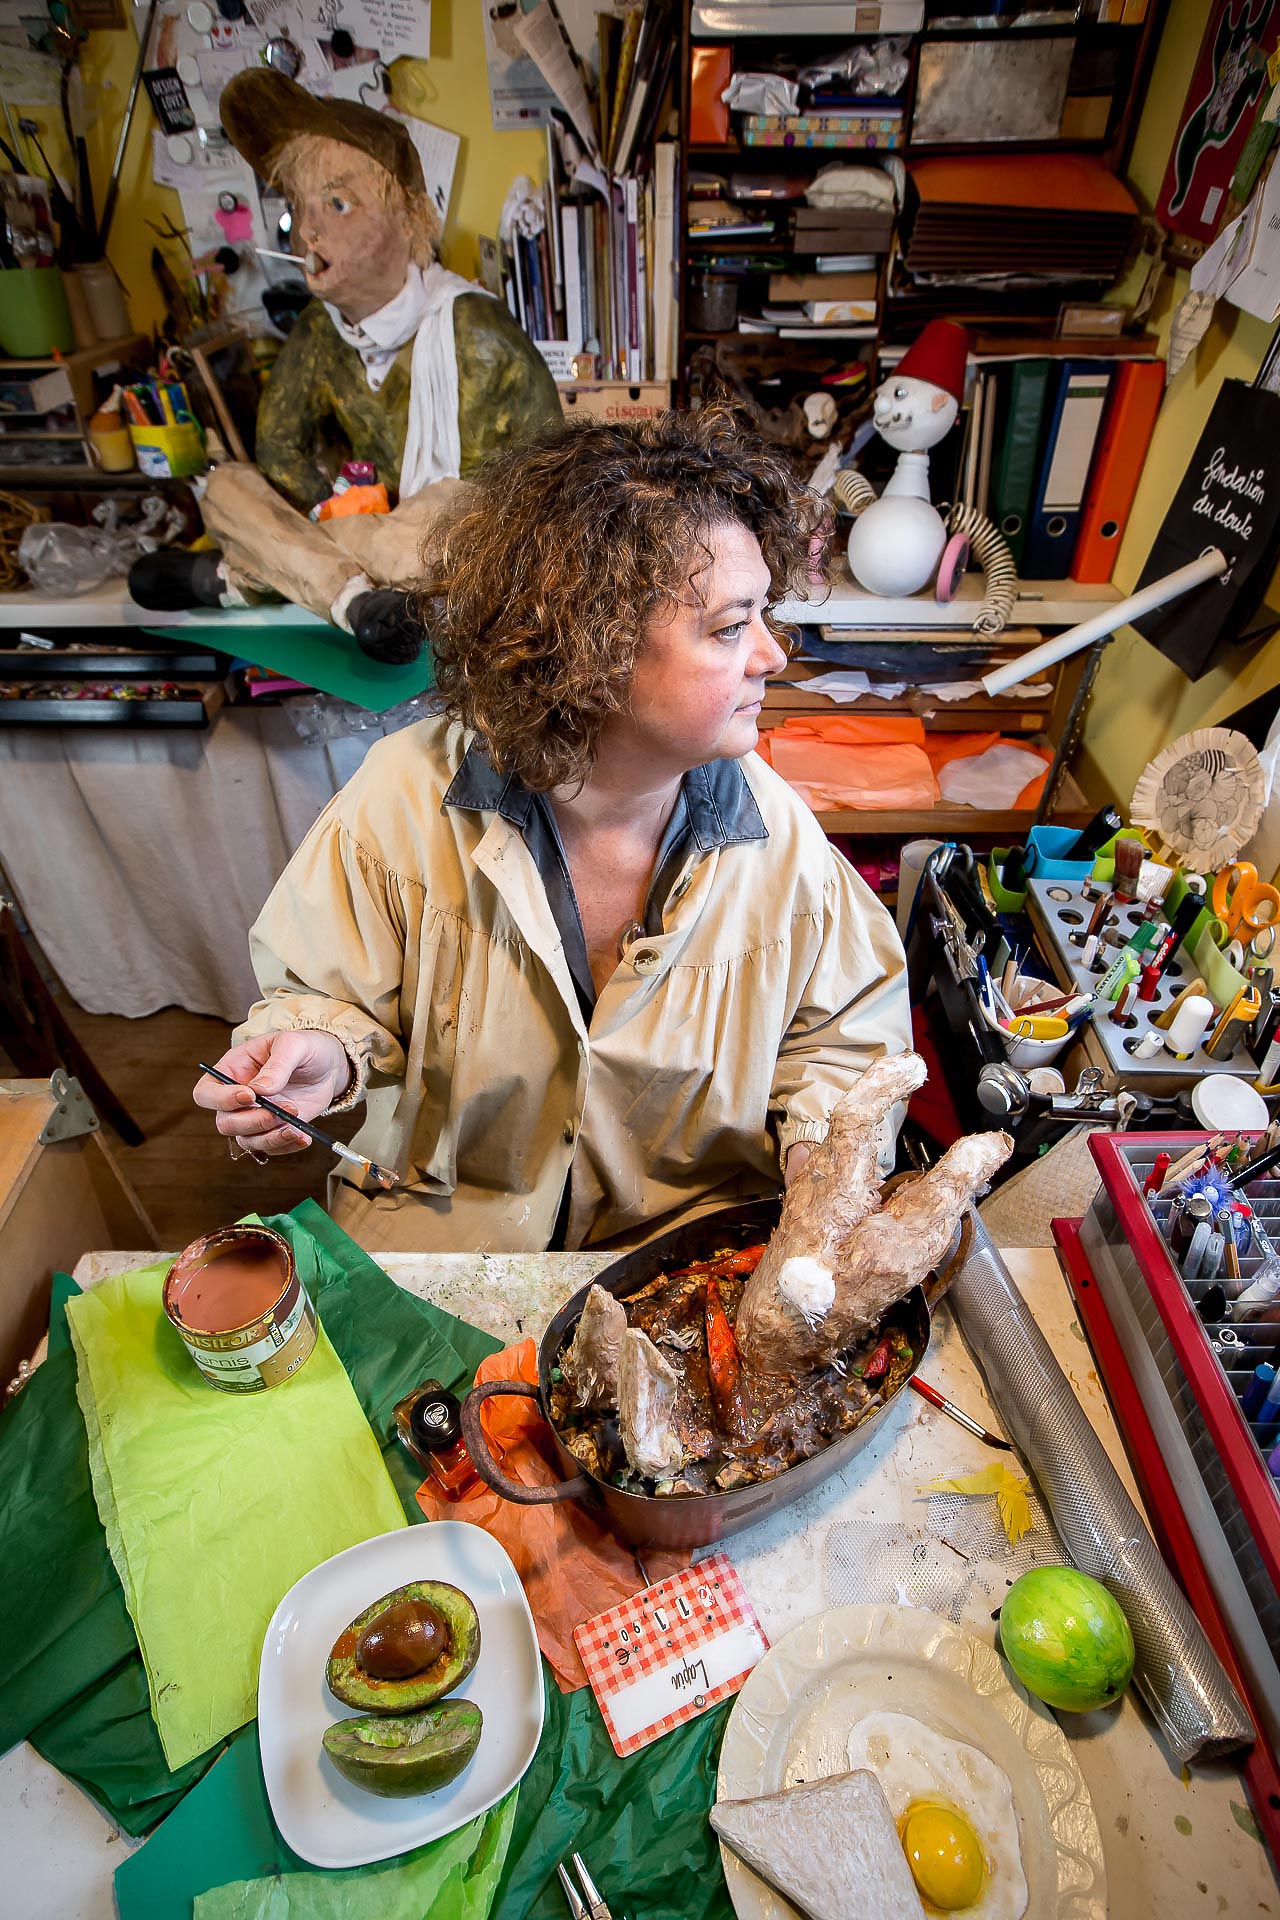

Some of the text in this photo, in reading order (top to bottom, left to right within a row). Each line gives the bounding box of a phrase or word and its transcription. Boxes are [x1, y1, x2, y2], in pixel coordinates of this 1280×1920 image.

[152, 78, 181, 96] DESIGN
[160, 93, 186, 111] LOVES
[1202, 446, 1265, 505] fondation
[1192, 494, 1253, 541] du doute
[671, 1658, 710, 1690] Lapin
